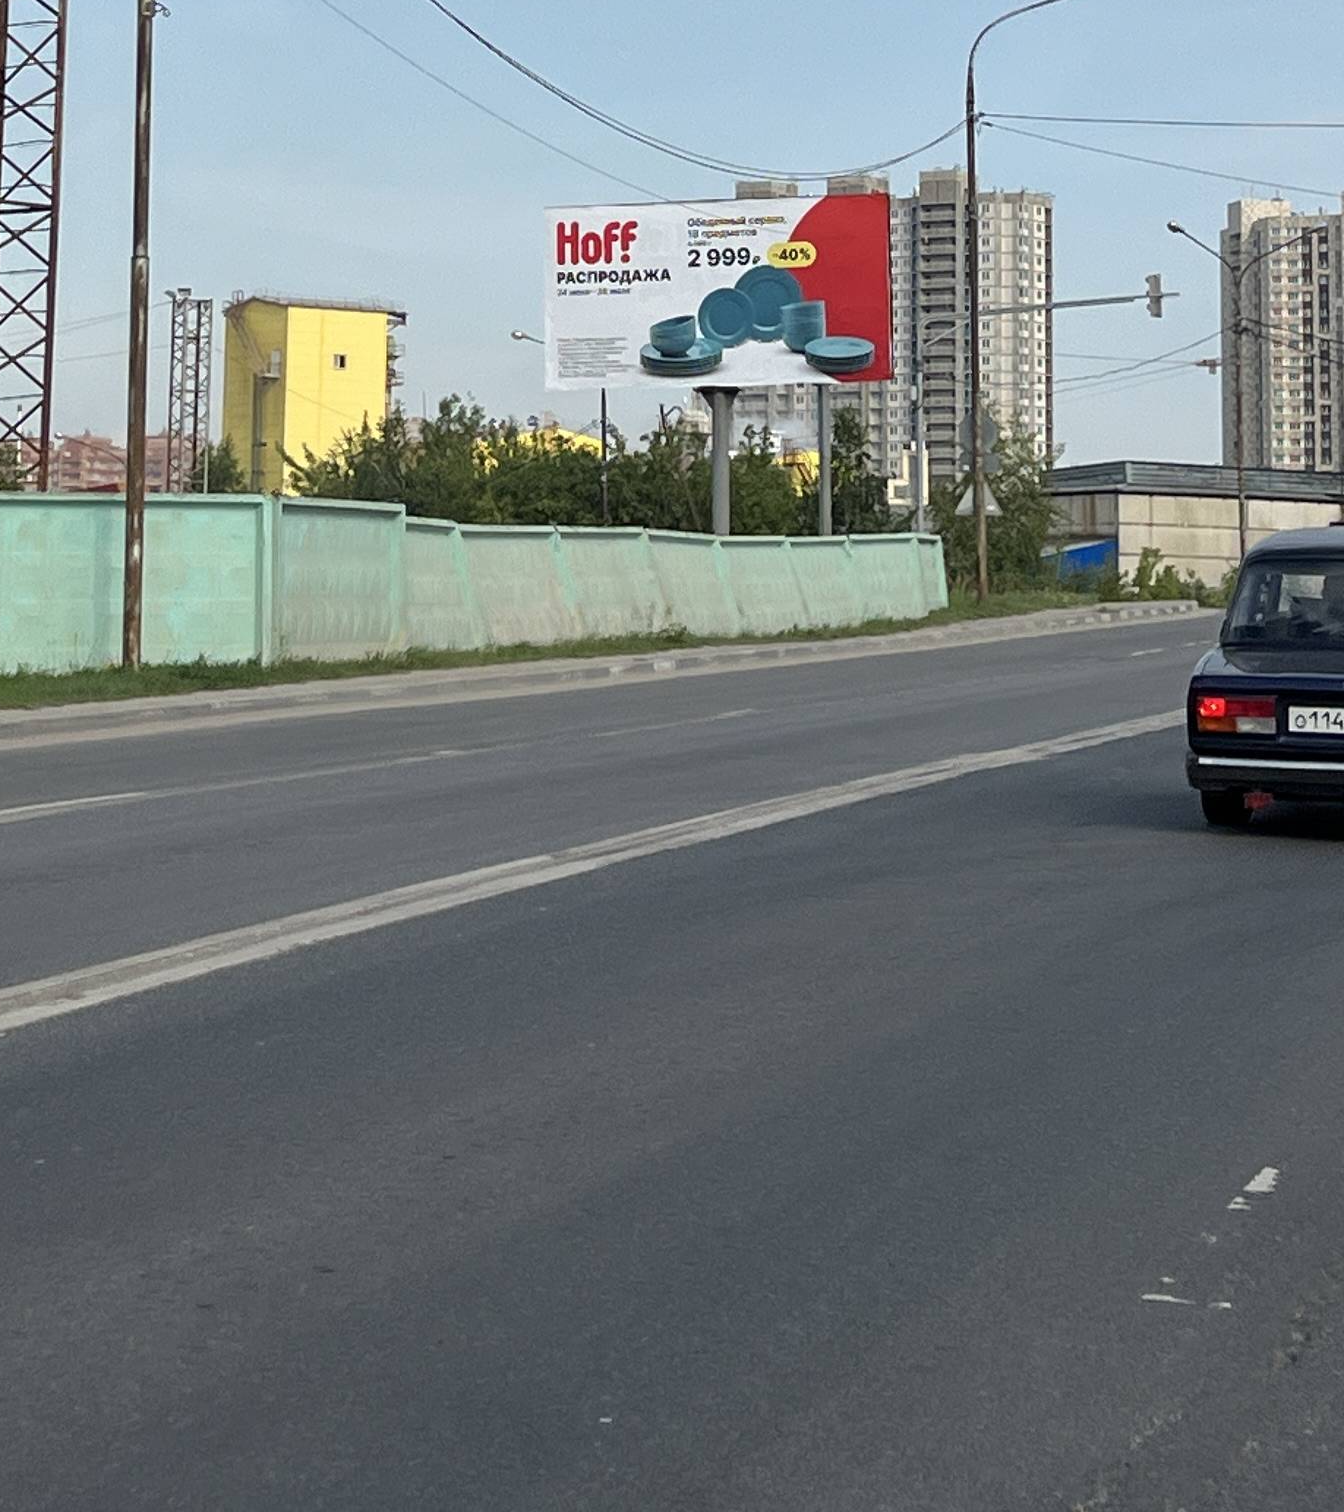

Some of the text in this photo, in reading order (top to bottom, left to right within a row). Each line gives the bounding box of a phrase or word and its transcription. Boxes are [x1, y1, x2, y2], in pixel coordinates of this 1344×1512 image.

[687, 249, 701, 268] 2
[706, 247, 751, 267] 999
[557, 269, 672, 286] РАСПРОДАЖА
